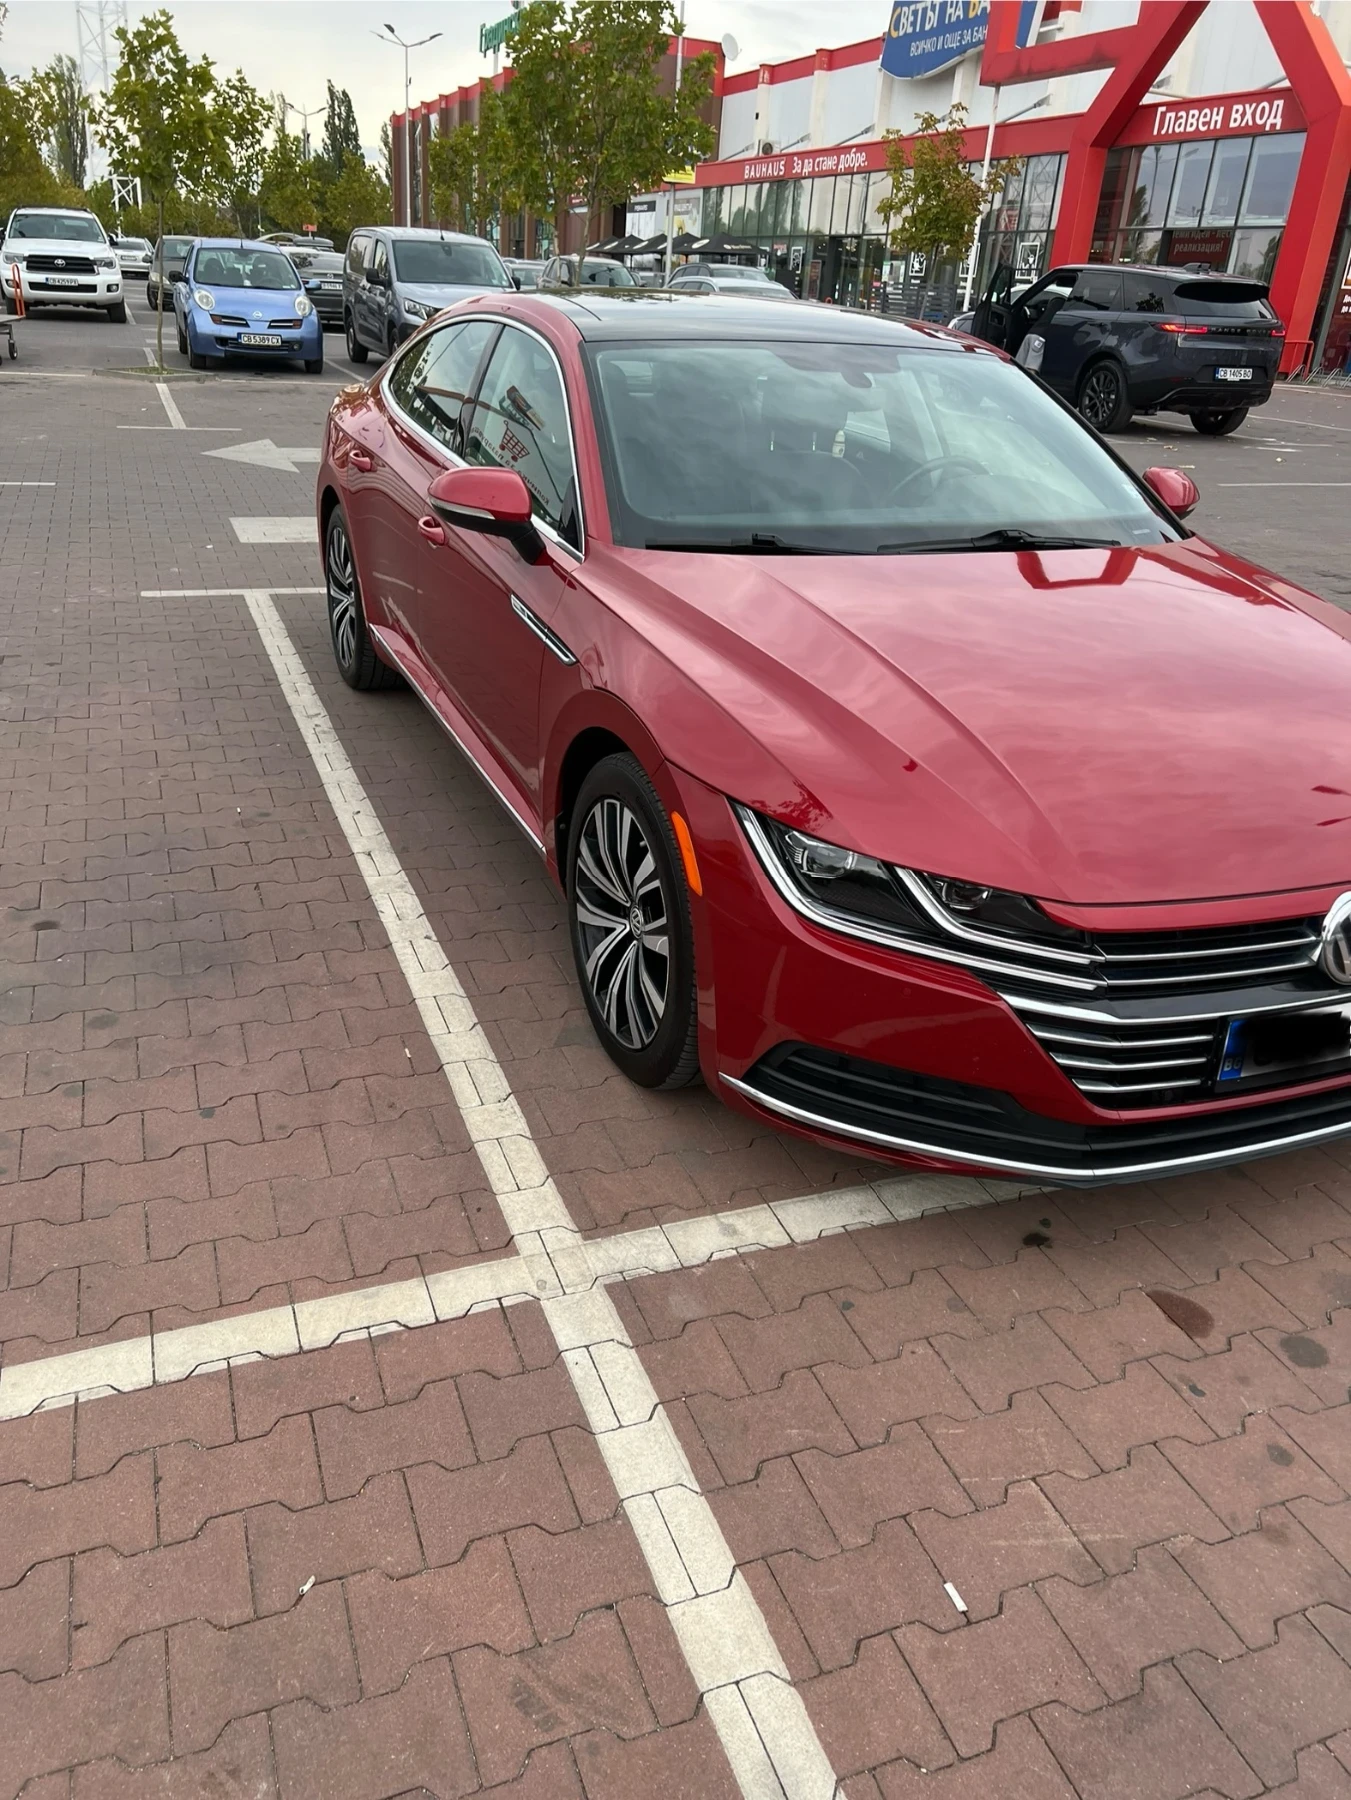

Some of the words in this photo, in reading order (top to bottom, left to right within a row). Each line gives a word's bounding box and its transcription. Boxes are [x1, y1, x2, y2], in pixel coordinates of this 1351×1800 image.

[910, 37, 937, 57] ВСИЧКО
[937, 35, 943, 51] И
[944, 30, 962, 49] ОЩЕ
[962, 28, 971, 45] ЗА
[972, 24, 988, 43] БАН
[1153, 104, 1225, 136] Главен
[1228, 99, 1285, 131] вход
[744, 160, 786, 179] BAUHAUS
[792, 156, 802, 174] За
[802, 158, 813, 176] да
[814, 155, 838, 172] стане
[838, 148, 868, 173] добре.
[1173, 240, 1224, 256] реализация!
[243, 334, 253, 343] CB
[253, 335, 270, 345] 5389
[1220, 369, 1228, 378] CB
[1229, 369, 1243, 378] 1405
[1223, 1057, 1243, 1072] BG
